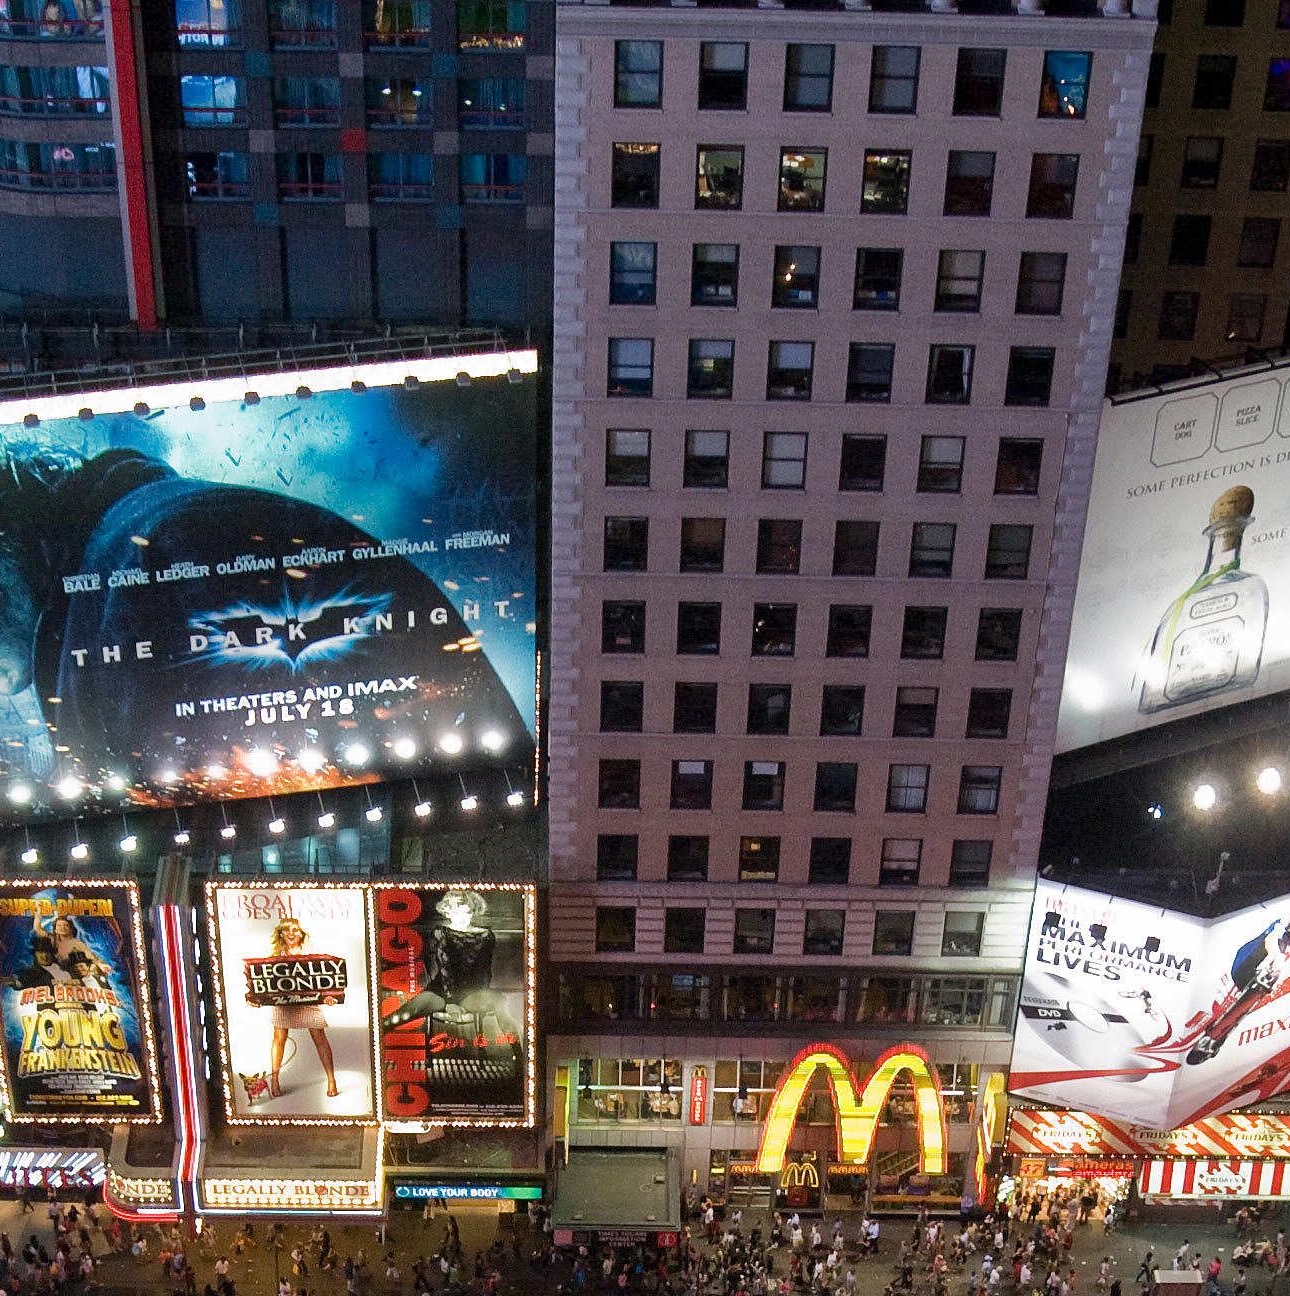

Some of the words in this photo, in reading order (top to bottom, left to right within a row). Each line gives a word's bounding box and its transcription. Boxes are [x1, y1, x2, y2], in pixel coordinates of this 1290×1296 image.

[1125, 483, 1168, 499] SOME
[1170, 460, 1256, 489] PERFECTION
[1259, 455, 1273, 467] IS
[1251, 530, 1288, 545] SOME
[64, 578, 101, 593] BALE
[108, 572, 150, 588] CAINE
[156, 565, 210, 582] LEDGER
[216, 557, 276, 575] OLDMAN
[282, 550, 346, 567] ECKHART
[352, 540, 438, 561] GYLLENHAAL
[445, 533, 510, 550] FREEMAN
[71, 641, 153, 667] THE
[190, 623, 307, 653] DARK
[343, 600, 510, 636] KNIGHT
[175, 701, 197, 718] IN
[201, 690, 298, 714] THEATERS
[302, 684, 343, 703] AND
[347, 675, 418, 698] IMAX
[244, 702, 311, 727] JULY
[322, 698, 356, 717] 18
[249, 960, 344, 979] LEGALLY
[1036, 947, 1121, 982] LIVES
[20, 986, 53, 1005] MEL
[253, 974, 346, 993] BLONDE
[21, 1008, 128, 1052] YOUNG
[18, 1048, 140, 1078] FRANKENSTEIN
[212, 1183, 290, 1196] LEGALLY
[412, 1186, 439, 1198] LOVE
[441, 1186, 468, 1198] YOUR
[469, 1186, 499, 1198] BODY
